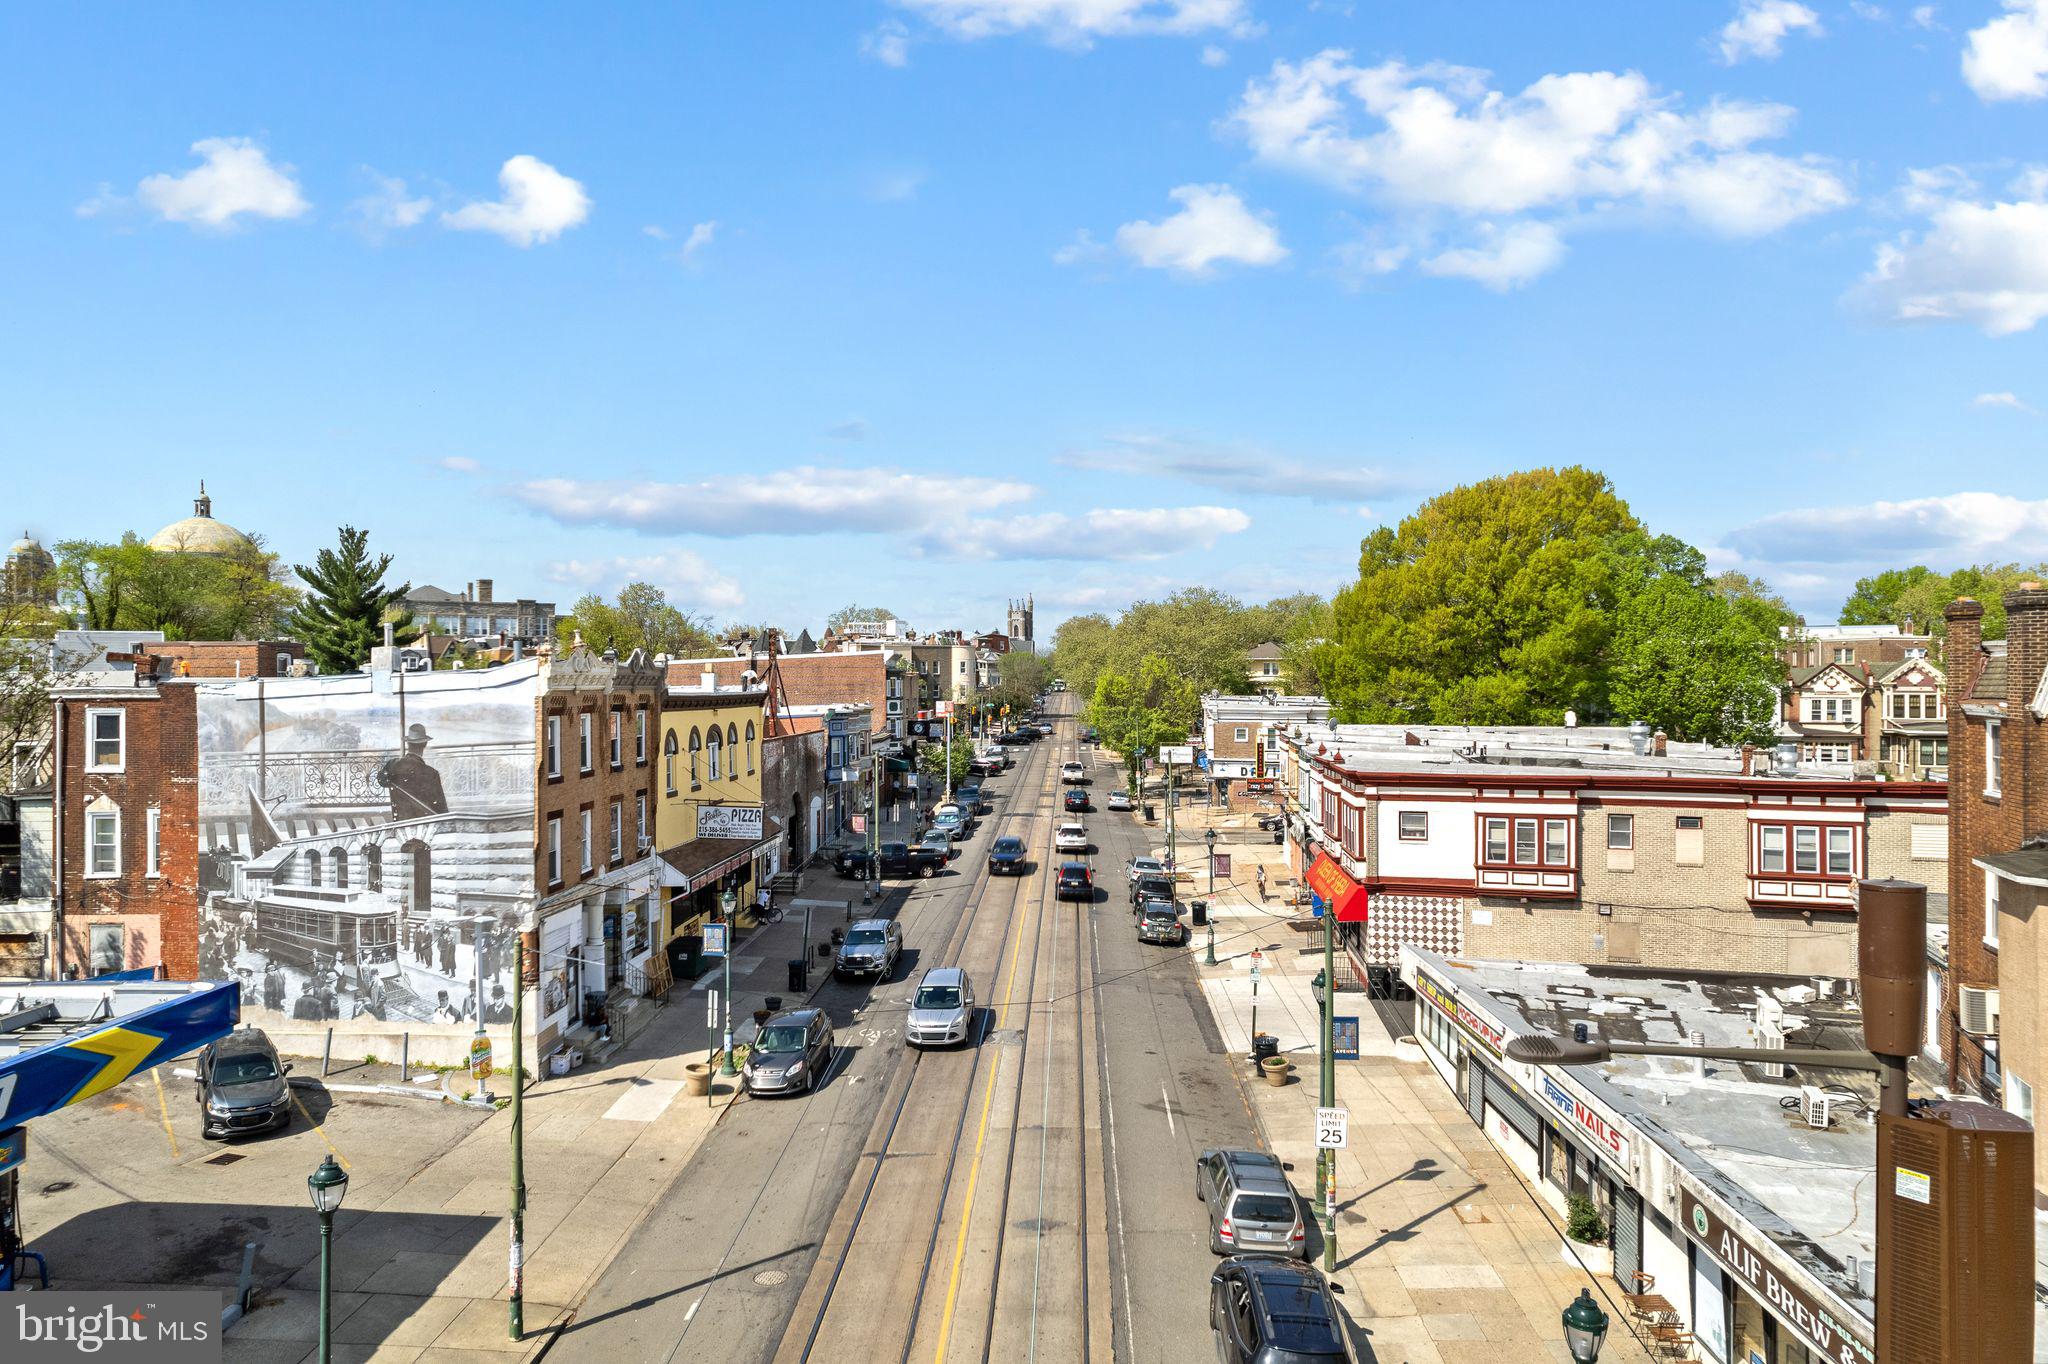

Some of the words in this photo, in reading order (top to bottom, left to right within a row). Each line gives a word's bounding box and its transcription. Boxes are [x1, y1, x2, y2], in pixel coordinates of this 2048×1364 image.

[731, 809, 762, 823] PIZZA
[1320, 1129, 1342, 1143] 25
[1575, 1101, 1620, 1152] NAILS
[1720, 1230, 1761, 1284] ALIF
[1766, 1270, 1831, 1348] BREW
